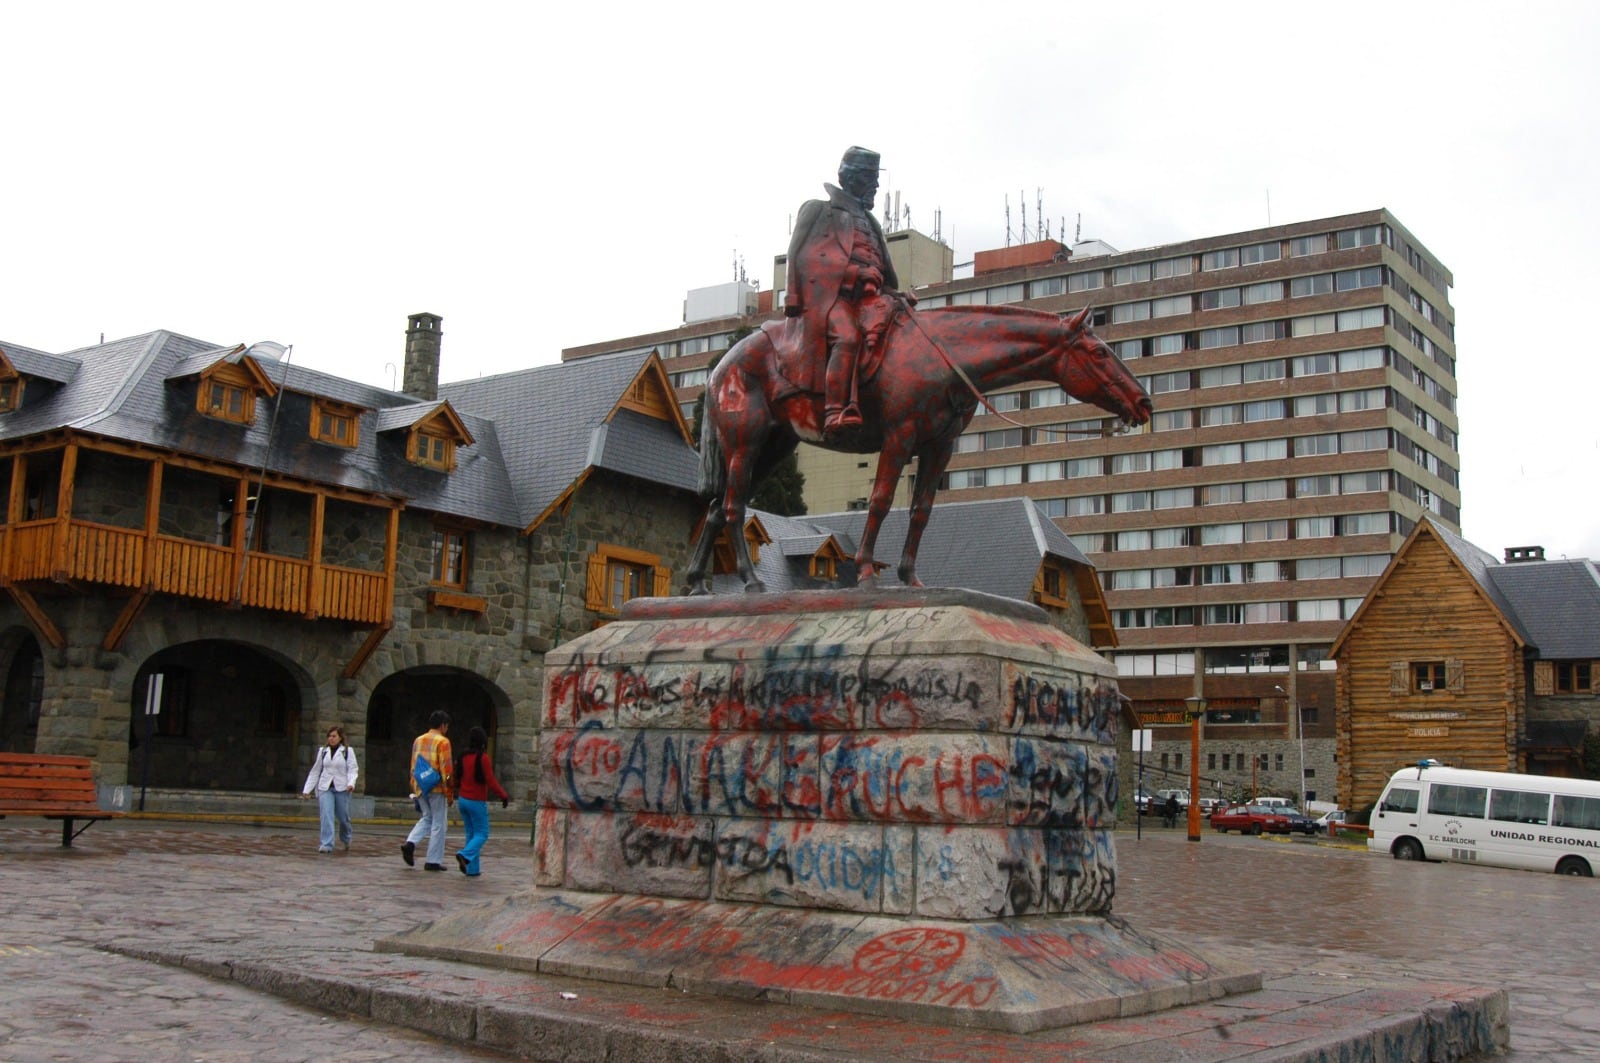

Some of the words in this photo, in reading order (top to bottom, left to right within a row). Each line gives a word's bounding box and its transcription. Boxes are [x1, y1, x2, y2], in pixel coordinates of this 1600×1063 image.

[1414, 728, 1441, 737] POLICIA
[1442, 836, 1476, 846] BARILOCHE
[1490, 829, 1535, 841] UNIDAD
[1538, 834, 1600, 848] REGIONAL
